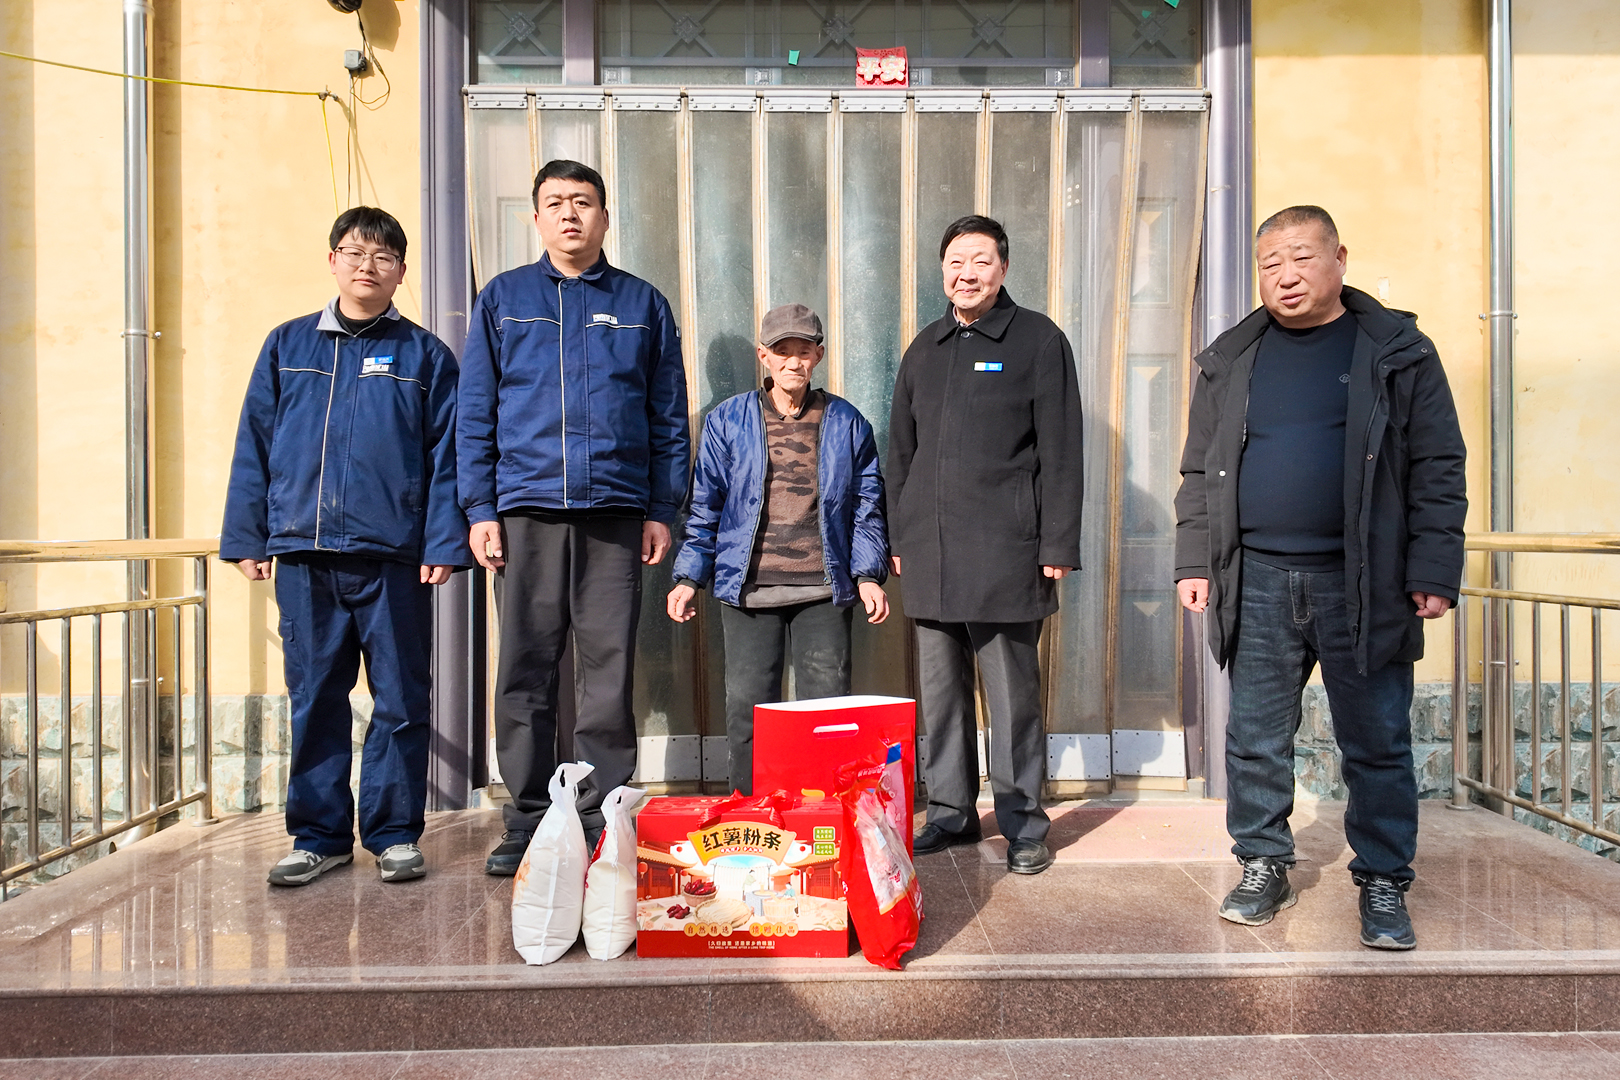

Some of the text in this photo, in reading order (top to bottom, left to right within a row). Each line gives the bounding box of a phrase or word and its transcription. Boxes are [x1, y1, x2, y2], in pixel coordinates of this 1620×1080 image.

[857, 55, 905, 82] 平安
[703, 827, 781, 852] 红薯粉条
[686, 924, 730, 935] 自然精选
[750, 924, 796, 935] 馈赠佳品
